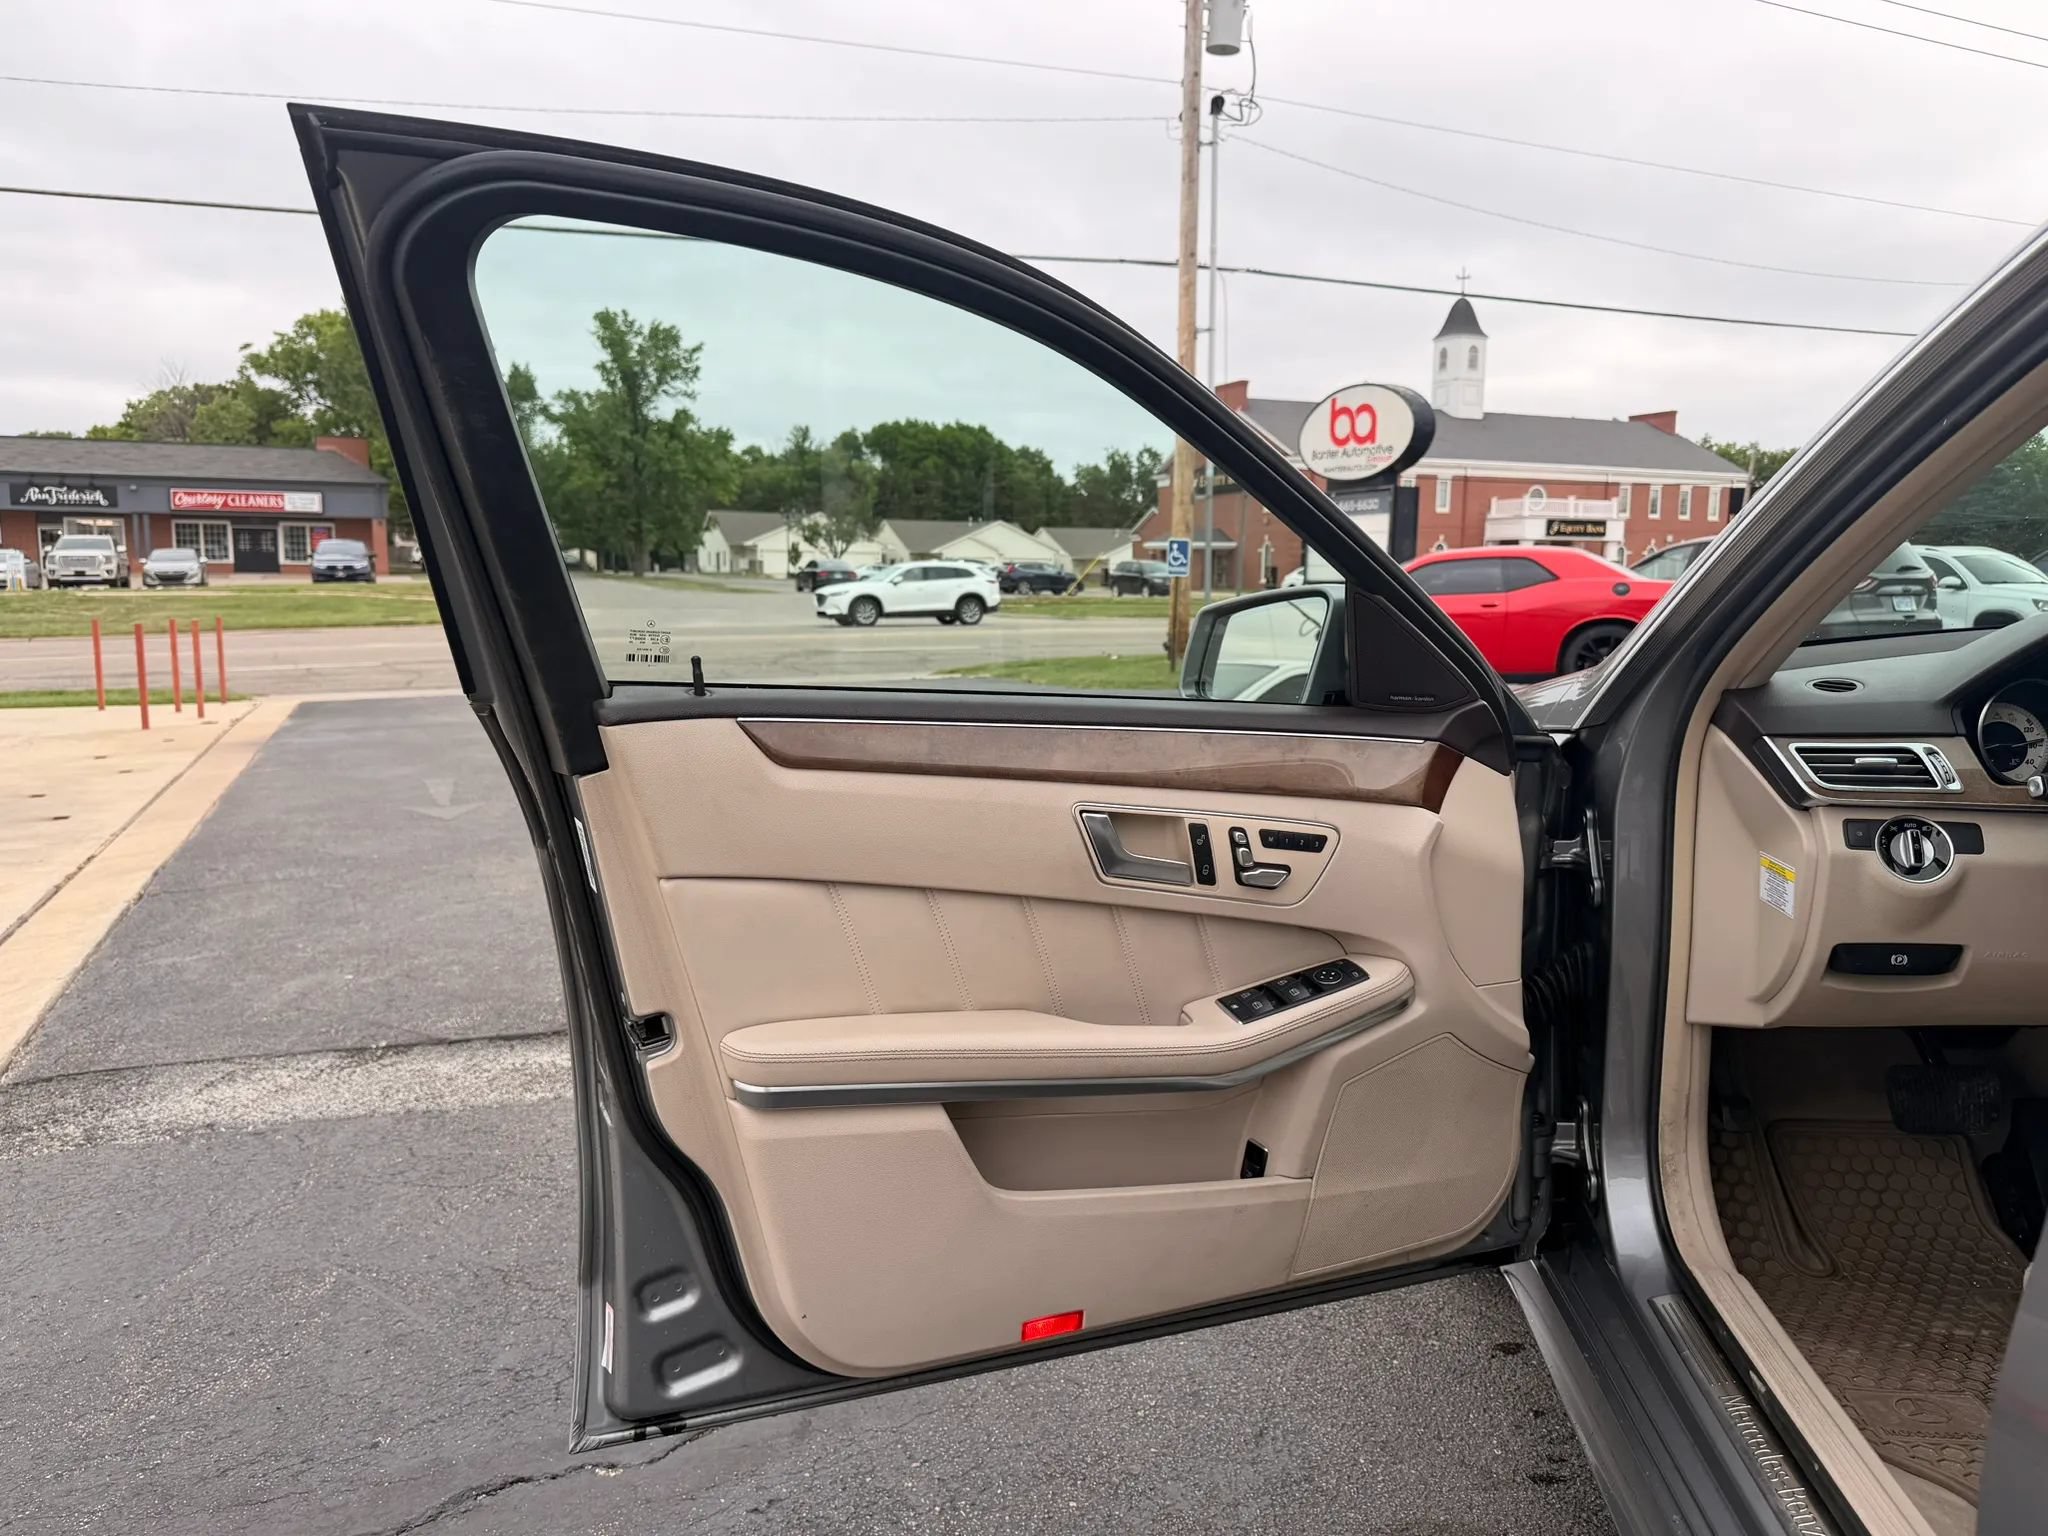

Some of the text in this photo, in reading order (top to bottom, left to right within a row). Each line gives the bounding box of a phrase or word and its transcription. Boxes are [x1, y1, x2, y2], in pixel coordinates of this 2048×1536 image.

[1341, 445, 1394, 460] Automotive
[174, 491, 226, 509] Courtesy
[227, 493, 284, 508] CLEANERS
